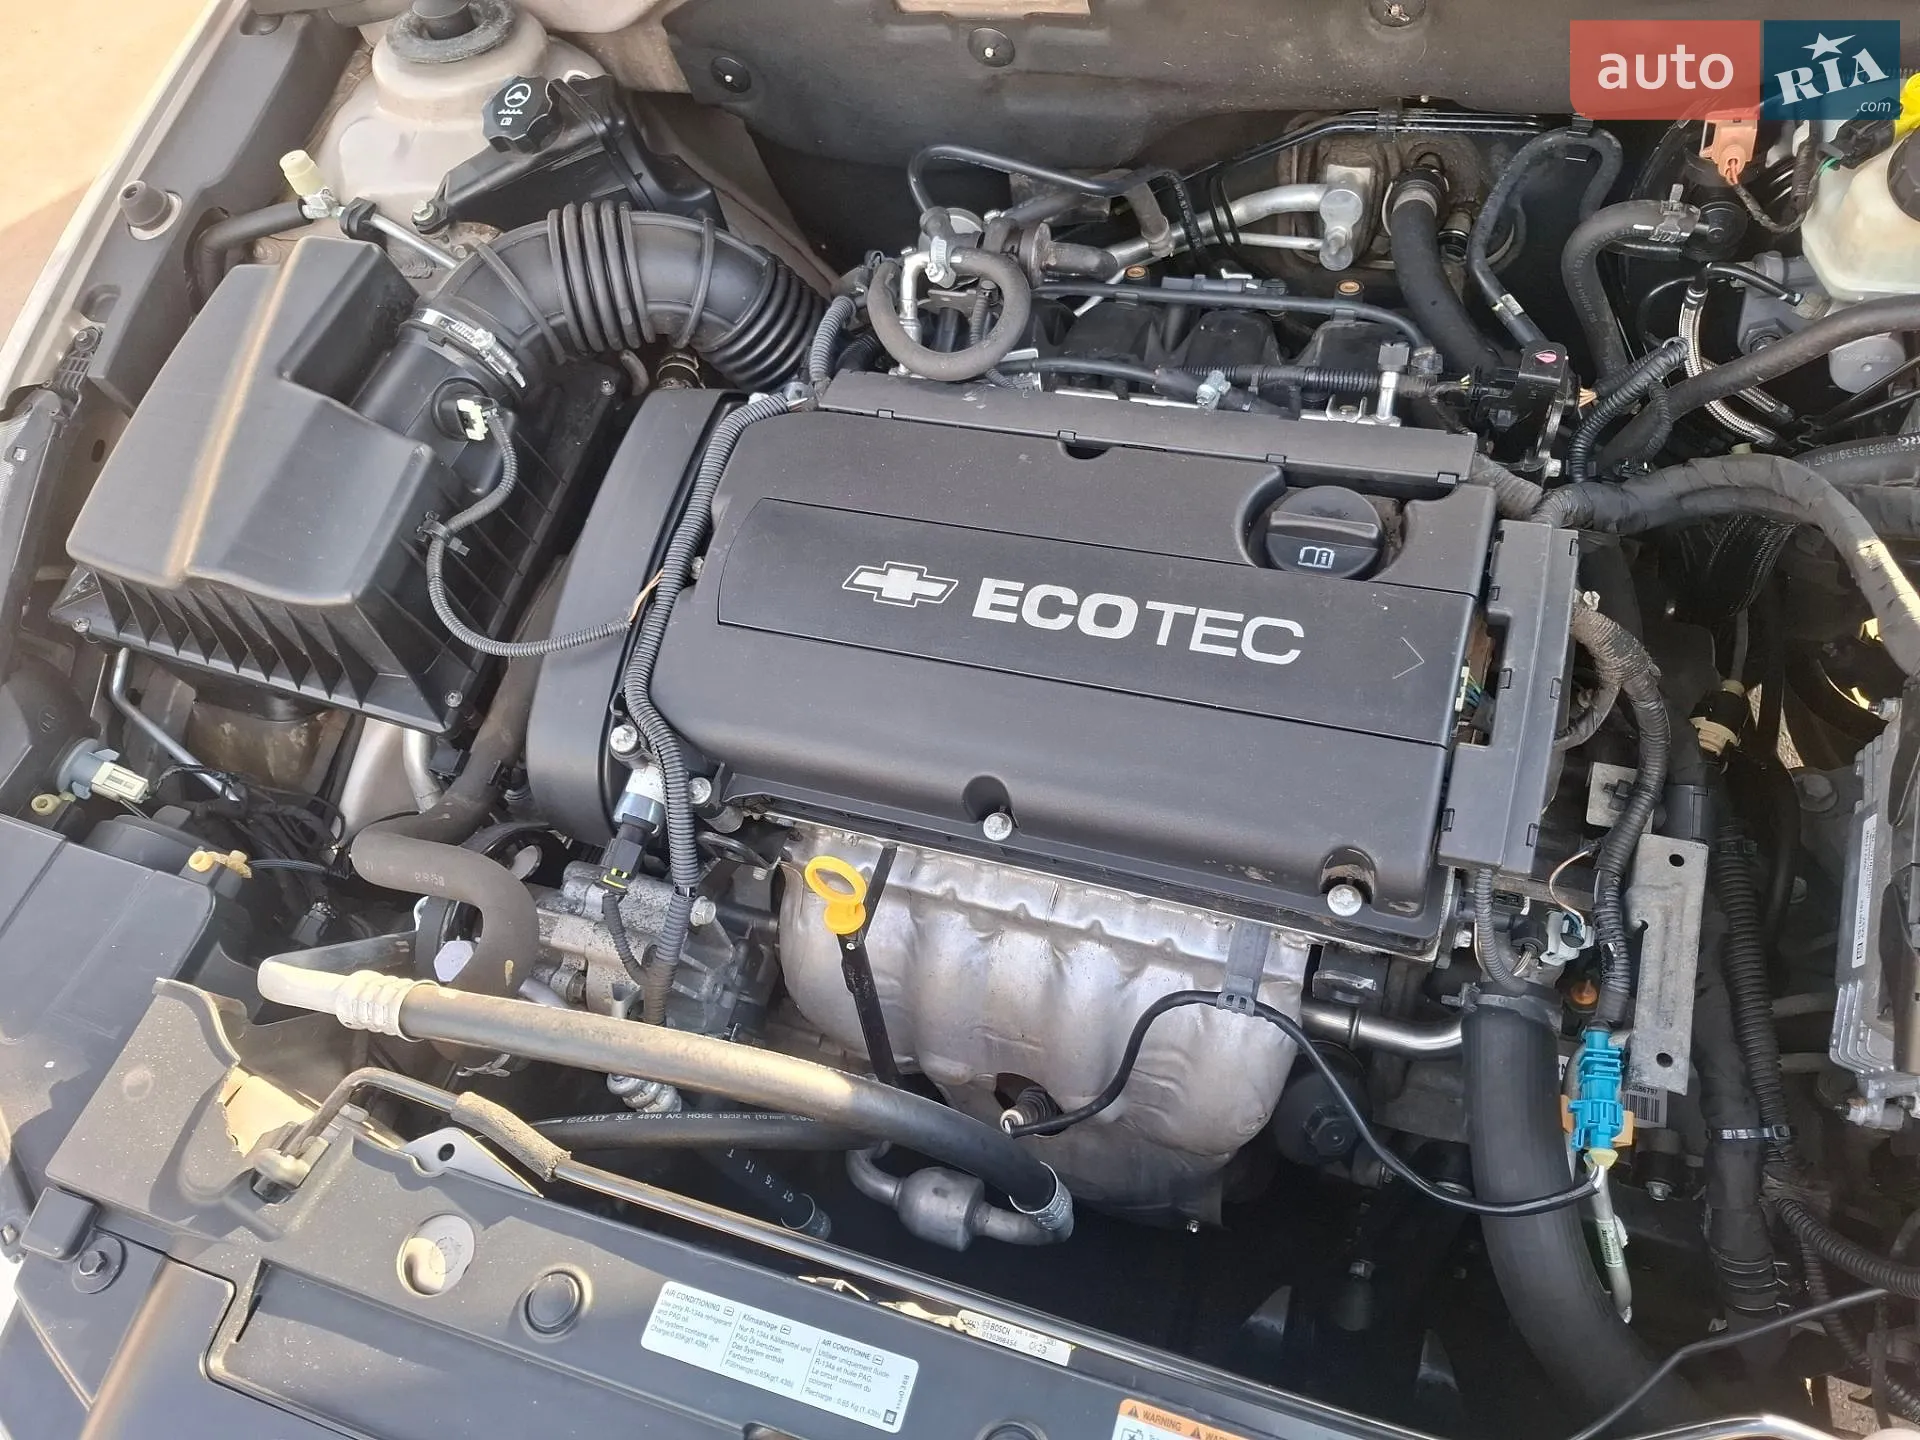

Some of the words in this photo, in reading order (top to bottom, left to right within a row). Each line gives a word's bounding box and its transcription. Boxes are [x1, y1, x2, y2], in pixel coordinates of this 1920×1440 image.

[971, 577, 1306, 666] ECOTEC
[566, 1114, 609, 1124] GALAXY
[677, 1293, 720, 1311] CONDITIONING
[669, 1311, 681, 1320] PAG
[743, 1314, 777, 1331] Klimaanlage
[989, 1322, 1012, 1336] BOSCH
[1142, 1409, 1182, 1431] WARNING
